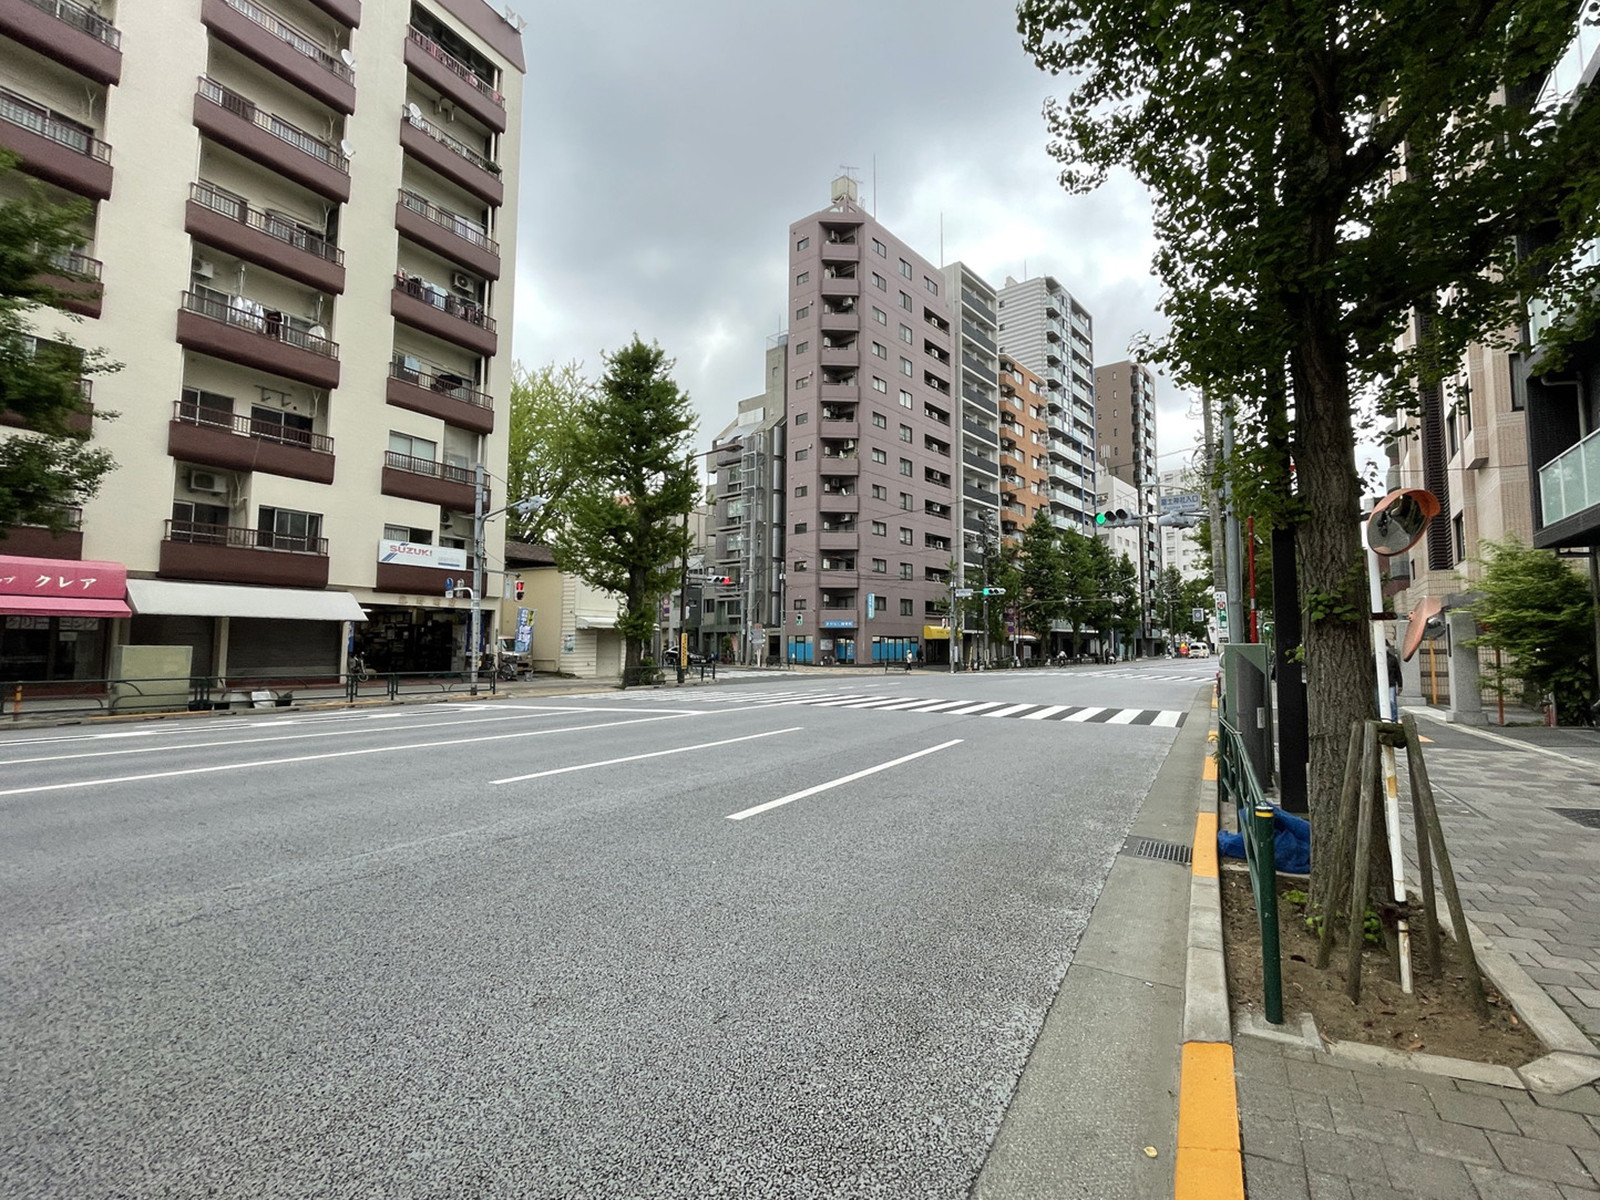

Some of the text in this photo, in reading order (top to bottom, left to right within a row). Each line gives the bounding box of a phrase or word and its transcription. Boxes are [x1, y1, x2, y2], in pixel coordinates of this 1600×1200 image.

[389, 544, 433, 557] SUZUKI
[35, 575, 97, 589] クレア
